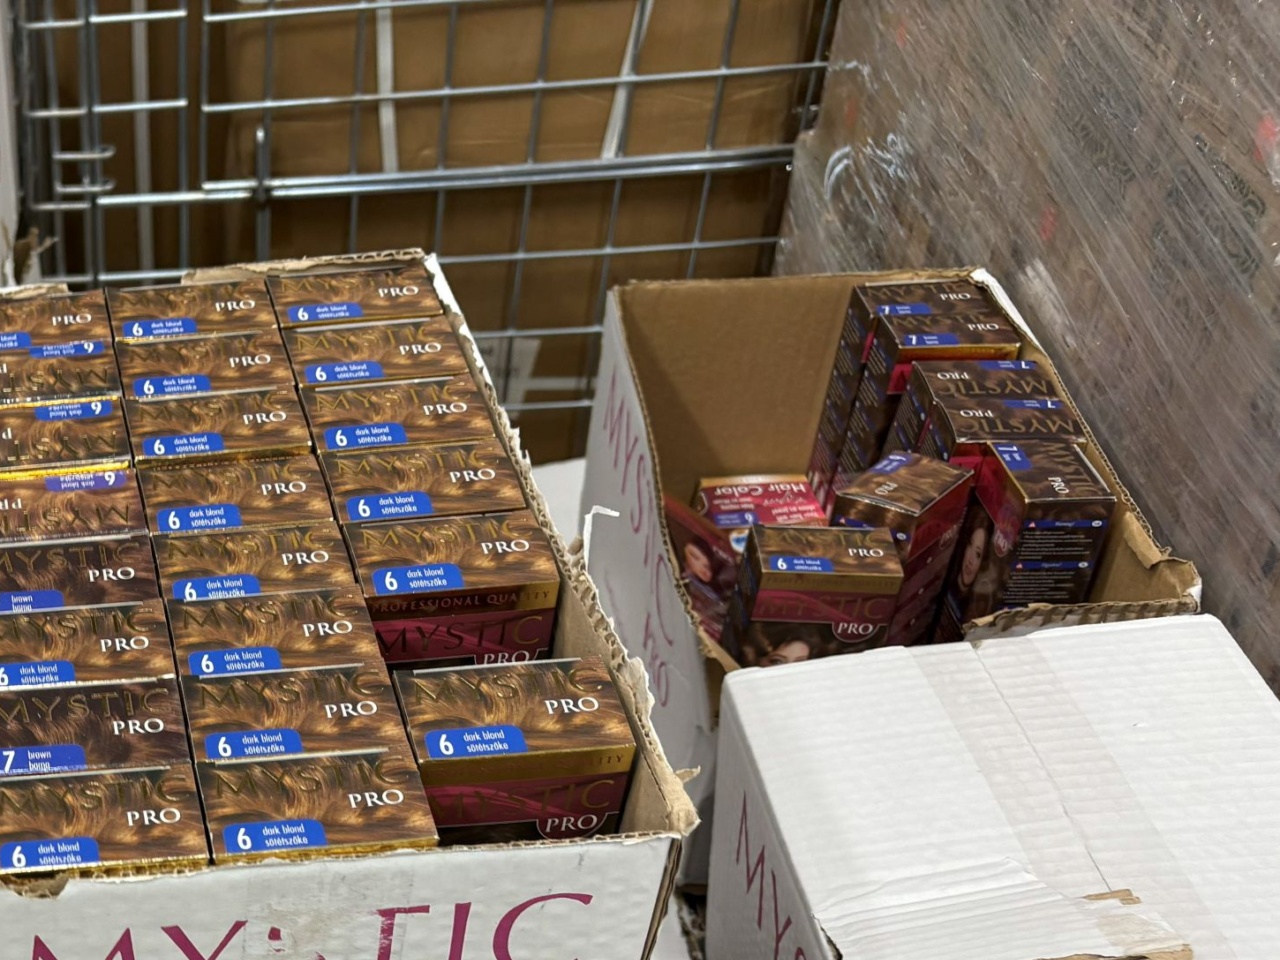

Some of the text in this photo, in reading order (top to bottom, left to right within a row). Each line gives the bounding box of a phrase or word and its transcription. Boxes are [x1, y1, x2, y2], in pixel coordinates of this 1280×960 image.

[378, 284, 419, 298] PRO
[214, 299, 256, 312] PRO
[51, 313, 92, 327] PRO
[399, 340, 442, 356] PRO
[229, 353, 271, 368] PRO
[242, 410, 287, 425] PRO
[422, 401, 467, 416] PRO
[153, 438, 166, 455] 6
[334, 429, 348, 447] 6
[449, 468, 496, 483] PRO
[261, 481, 307, 496] PRO
[357, 494, 415, 517] 6 dark blond
[167, 507, 224, 530] 6 dark blond
[480, 538, 530, 555] PRO
[281, 549, 329, 566] PRO
[88, 566, 135, 583] PRO
[384, 566, 444, 591] 6 dark blond
[184, 577, 243, 601] 6 dark blond
[302, 619, 353, 637] PRO
[836, 622, 874, 635] PRO
[99, 635, 150, 652] PRO
[201, 650, 263, 673] 6 dark blond
[324, 700, 378, 719] PRO
[544, 696, 600, 715] PRO
[112, 717, 165, 736] PRO
[217, 732, 283, 757] 6 dark blond
[438, 729, 505, 756] 6 dark blond
[348, 789, 404, 808] PRO
[126, 807, 181, 827] PRO
[545, 813, 598, 833] PRO
[236, 822, 305, 850] 6 dark blond
[11, 842, 80, 868] 6 dark blond
